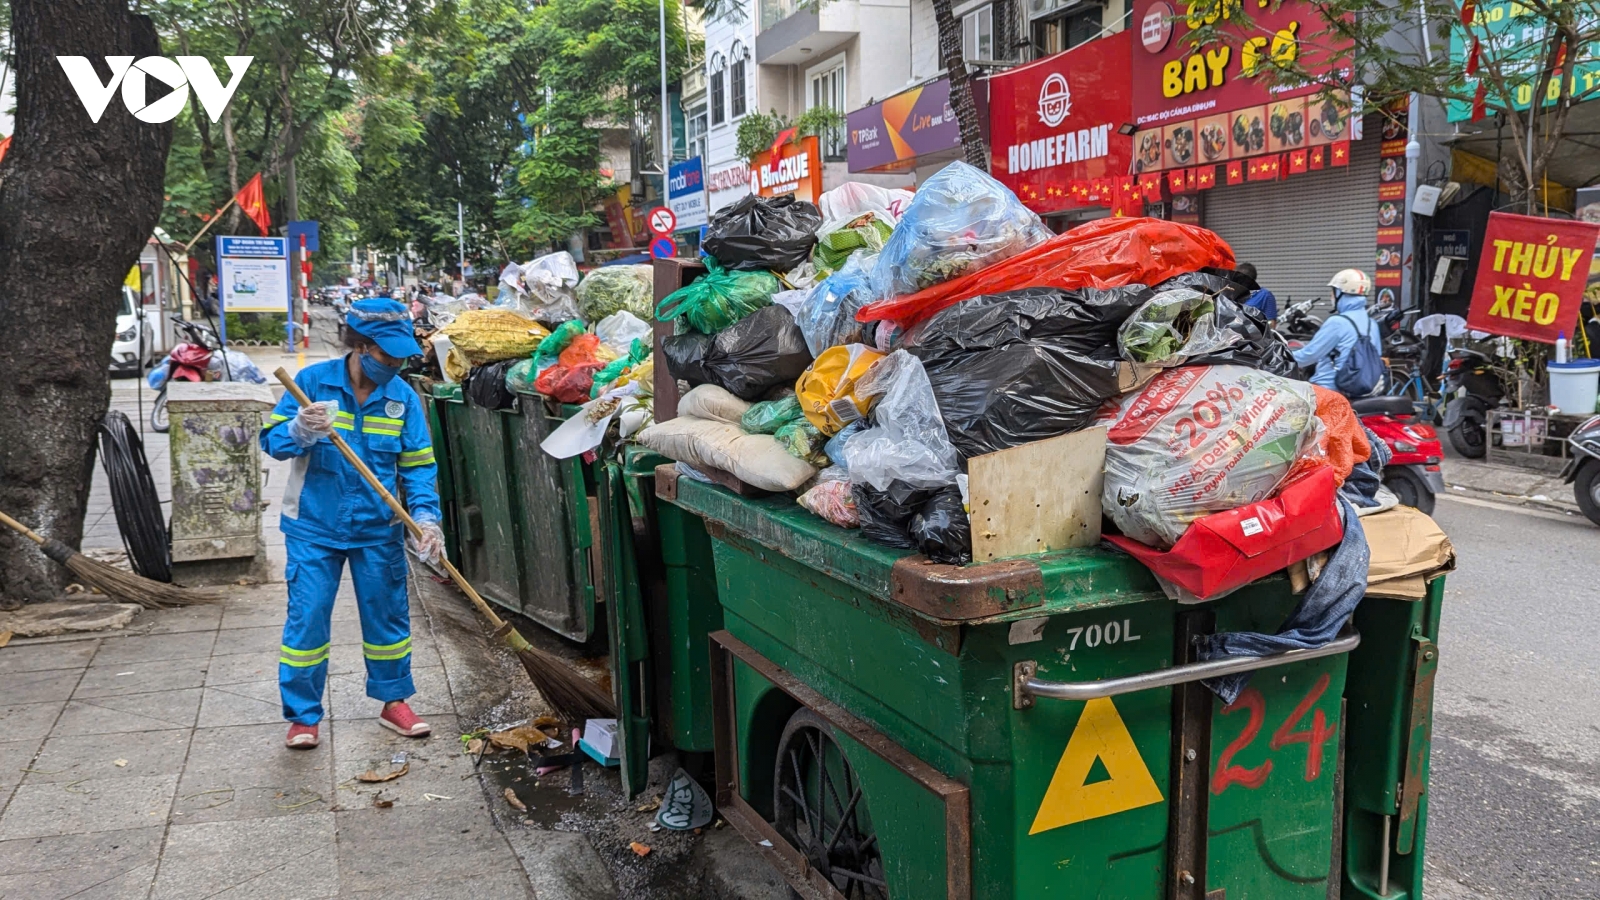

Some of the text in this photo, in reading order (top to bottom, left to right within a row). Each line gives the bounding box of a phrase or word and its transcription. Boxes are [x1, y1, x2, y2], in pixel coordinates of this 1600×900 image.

[1163, 40, 1231, 98] BẢY
[858, 126, 878, 144] TPBank
[1008, 124, 1108, 175] HOMEFARM
[670, 168, 701, 193] mobifone
[1492, 234, 1584, 281] THỦY
[1487, 283, 1560, 326] XÈO
[1174, 381, 1245, 449] 20%
[1168, 387, 1278, 497] MEATDeli & WinEco
[1066, 618, 1142, 651] 700L
[1210, 672, 1338, 797] 24
